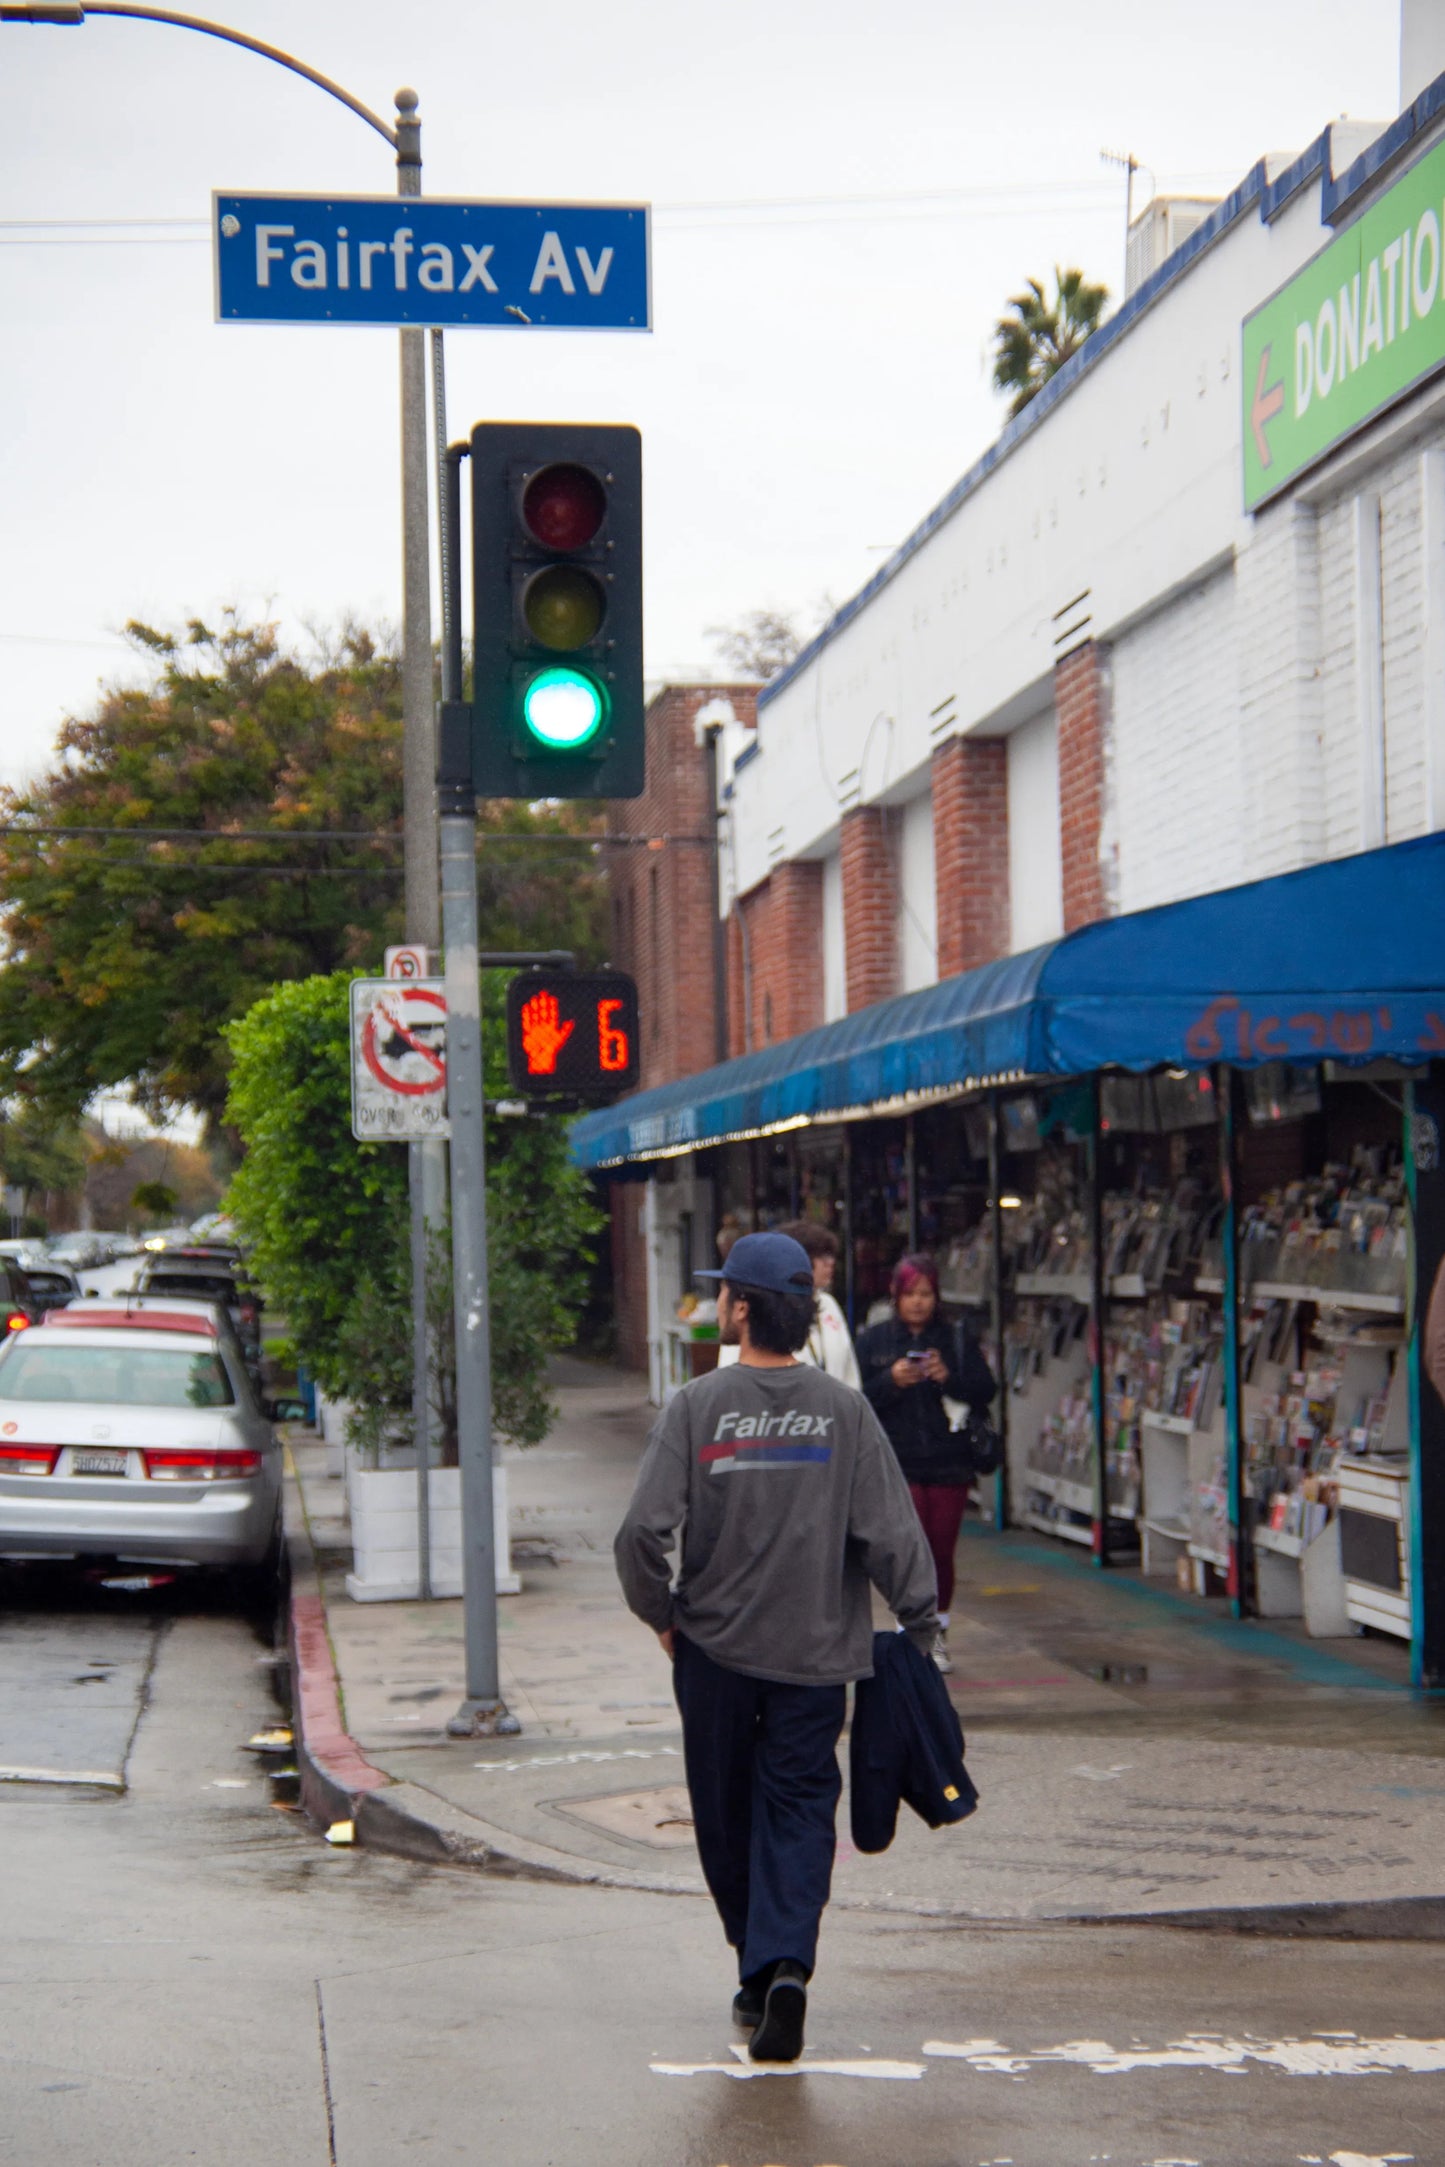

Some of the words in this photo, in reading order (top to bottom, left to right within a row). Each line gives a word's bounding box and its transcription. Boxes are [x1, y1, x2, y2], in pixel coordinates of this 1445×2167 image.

[255, 223, 498, 293] Fairfax
[529, 231, 614, 295] Av
[1294, 198, 1445, 420] DONATIO
[597, 998, 629, 1072] 6
[713, 1409, 834, 1441] Fairfax
